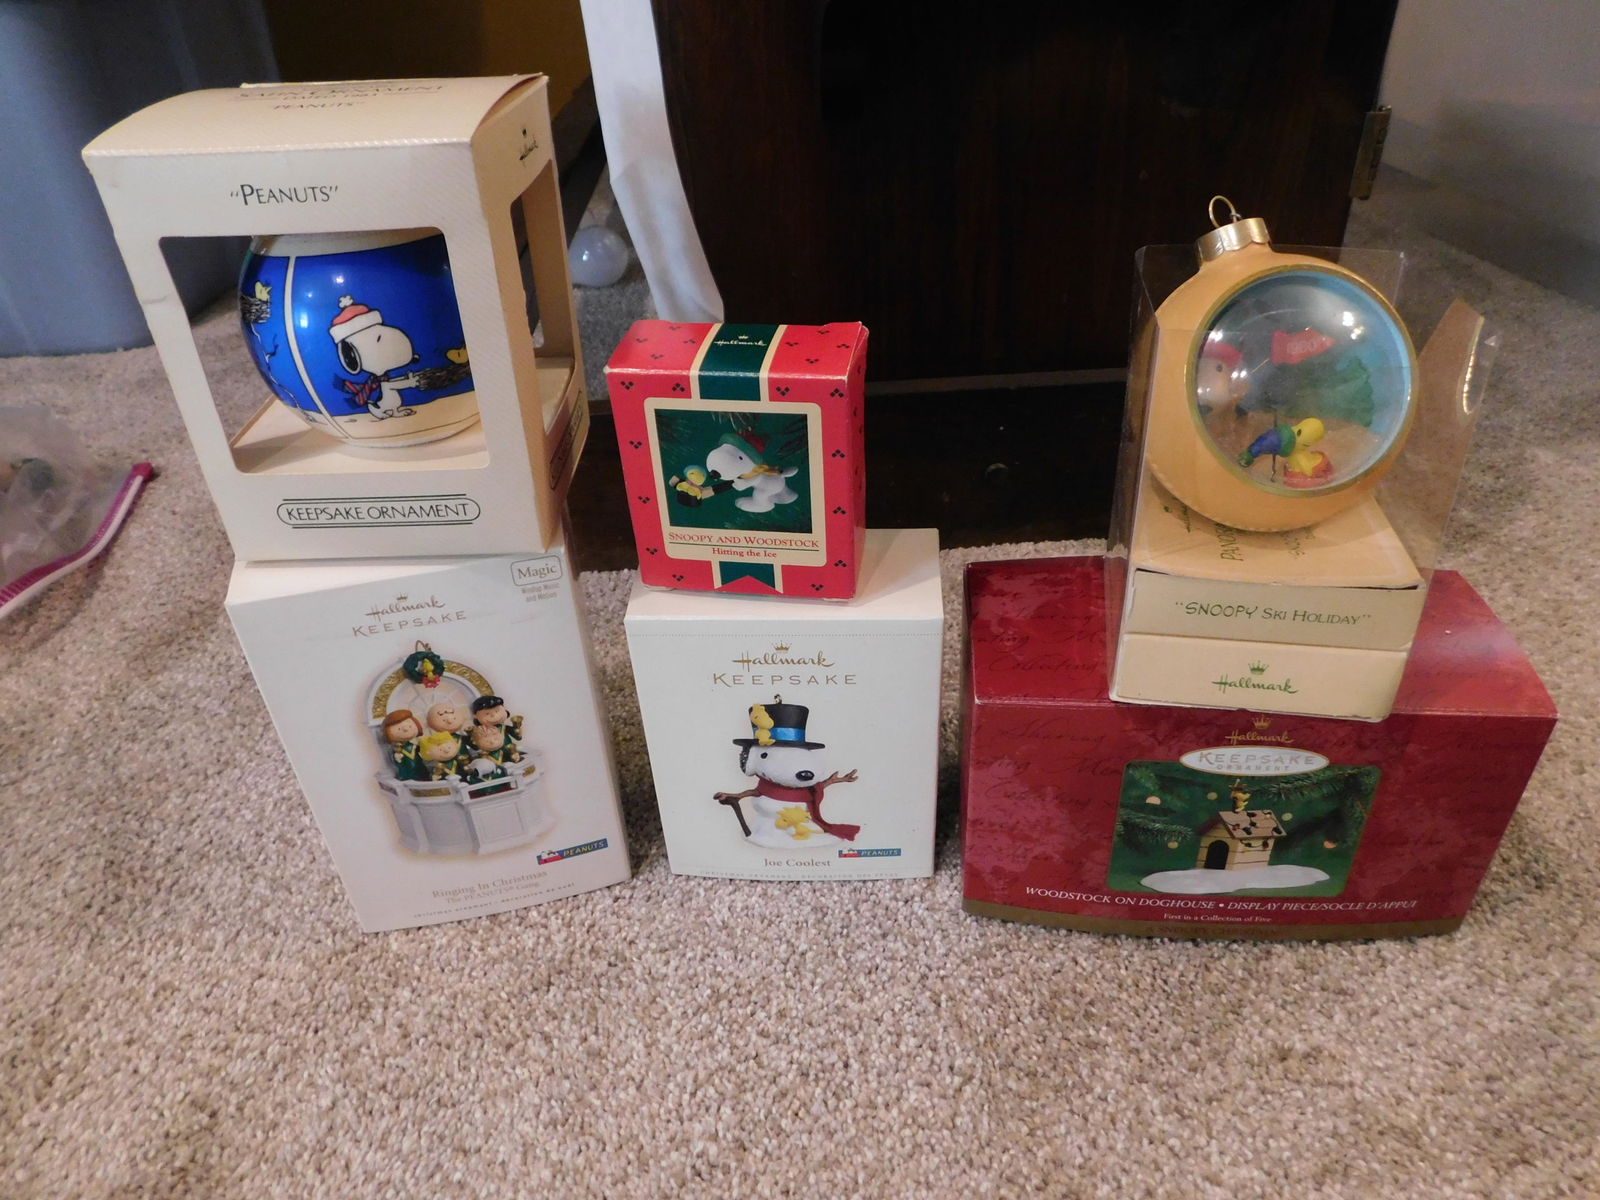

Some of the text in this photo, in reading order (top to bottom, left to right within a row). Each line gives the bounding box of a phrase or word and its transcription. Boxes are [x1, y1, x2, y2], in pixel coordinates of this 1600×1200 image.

[230, 183, 339, 206] "PEANUTS"
[713, 339, 767, 347] Hallmark
[286, 503, 469, 521] KEEPSAKE ORNAMENT
[668, 531, 820, 549] SNOOPY AND WOODSTOCK
[712, 547, 778, 558] Hitting the Ice
[517, 563, 558, 580] Magic
[365, 595, 445, 621] Hallmark
[1175, 601, 1372, 626] "SNOOPY SKI HOLIDAY"
[352, 610, 468, 638] KEEPSAKE
[732, 650, 836, 672] Hallmark
[713, 673, 857, 688] KEEPSAKE
[1211, 673, 1300, 695] Hallmark
[1225, 729, 1294, 746] Hallmark
[1199, 752, 1315, 765] KEEPSAKE
[564, 841, 605, 857] PEANUTS
[764, 858, 831, 867] Joe Coolest
[492, 871, 548, 888] Christmas
[1025, 886, 1112, 904] WOODSTOCK
[1114, 896, 1137, 905] ON
[1138, 898, 1215, 910] DOGHOUSE
[1227, 902, 1281, 911] DISPLAY
[1163, 913, 1181, 921] First
